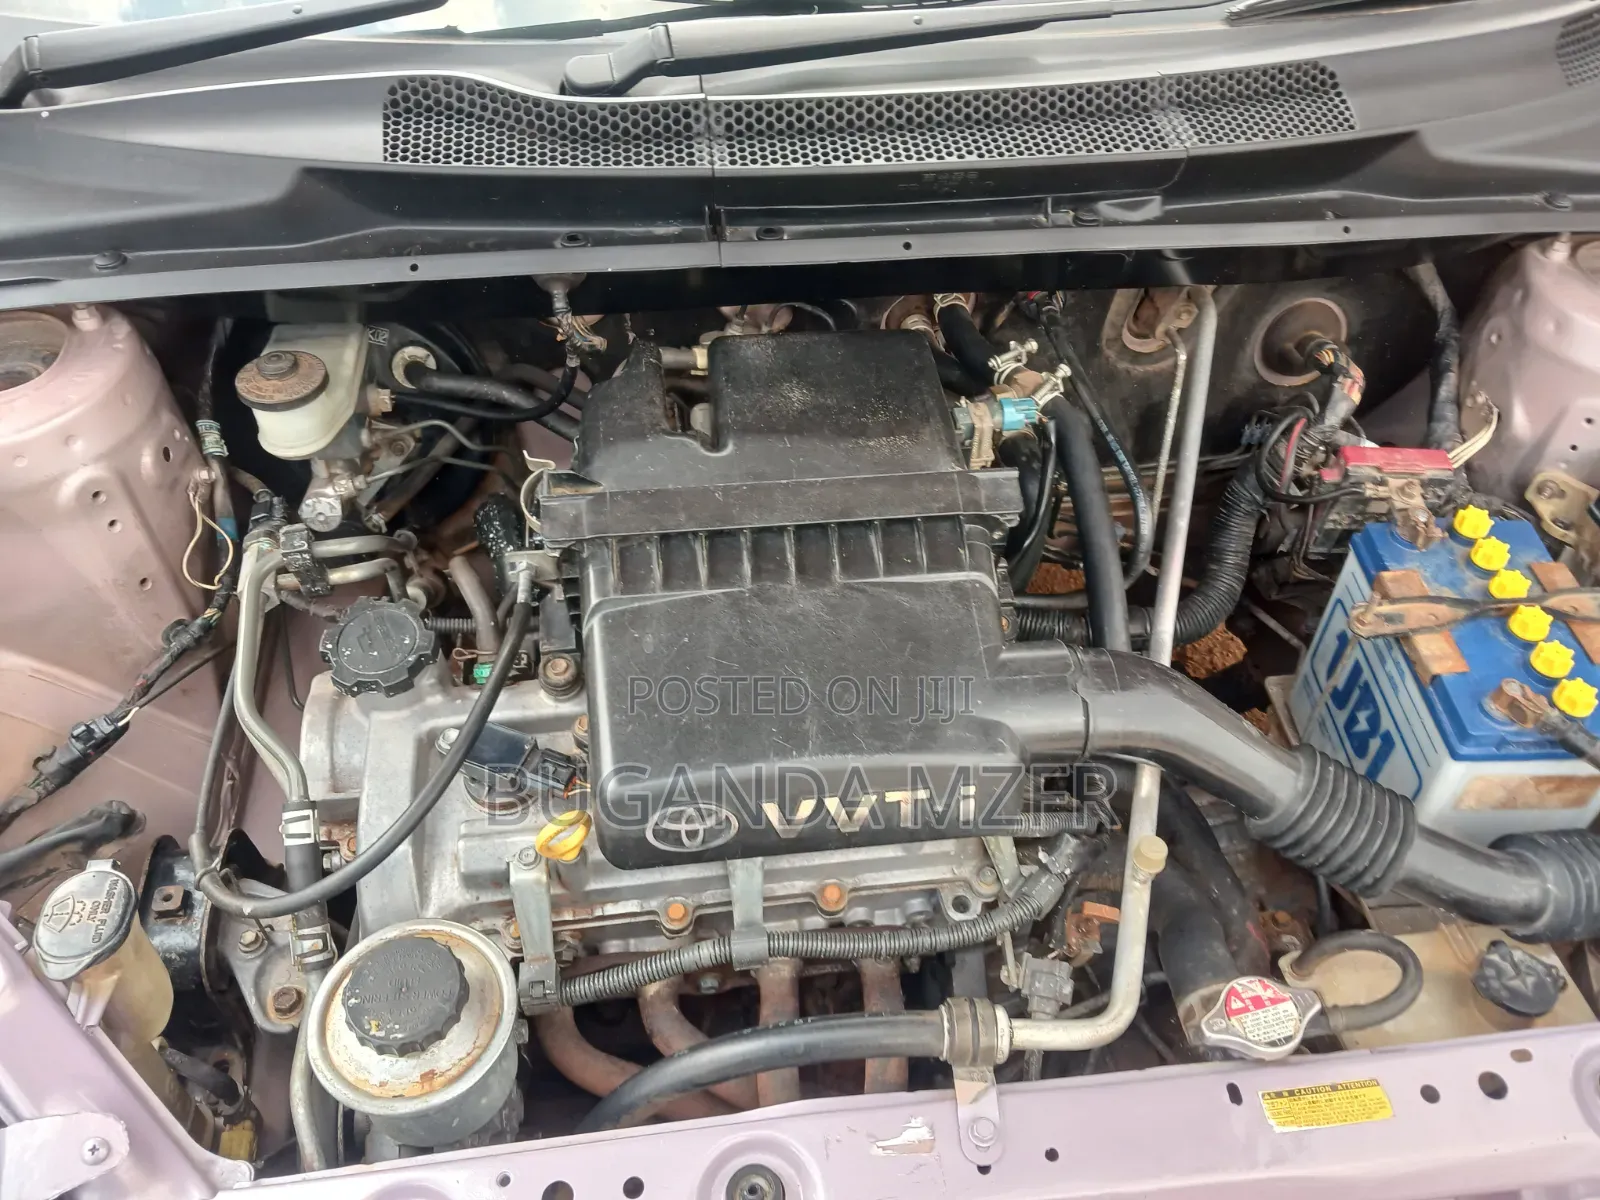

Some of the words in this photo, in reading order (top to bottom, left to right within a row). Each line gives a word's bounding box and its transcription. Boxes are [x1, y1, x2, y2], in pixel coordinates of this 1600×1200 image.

[100, 877, 120, 914] WASHER
[86, 900, 102, 923] ONLY
[91, 918, 108, 944] FLUID
[1294, 1084, 1332, 1096] CAUTION
[1337, 1080, 1378, 1090] ATTENTION
